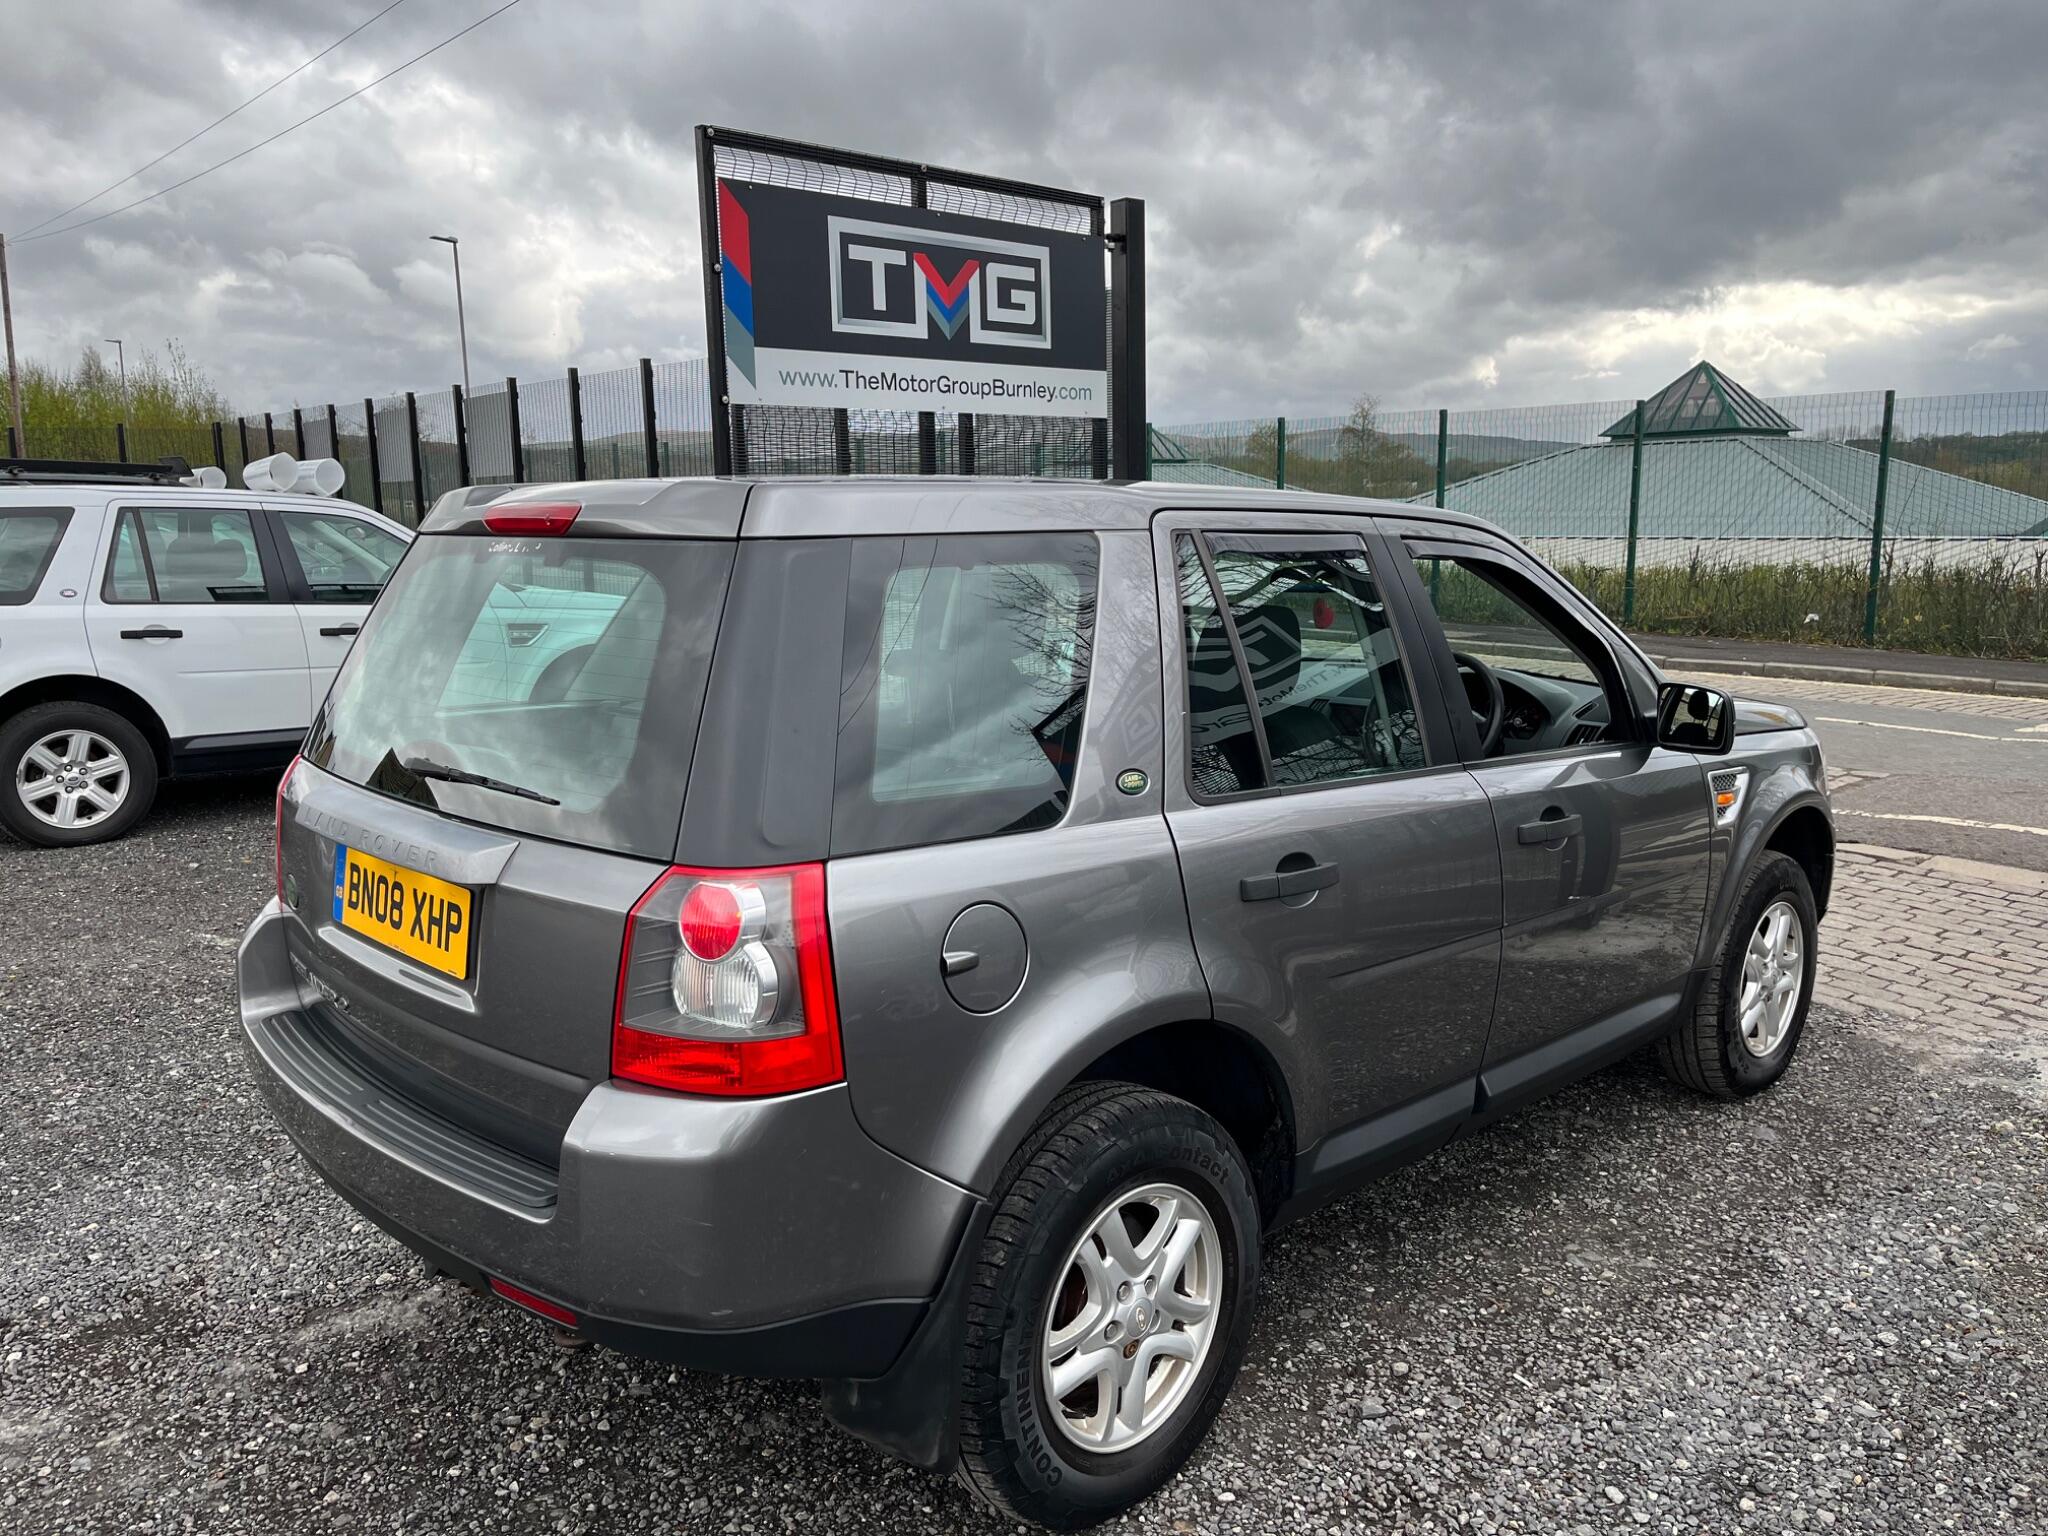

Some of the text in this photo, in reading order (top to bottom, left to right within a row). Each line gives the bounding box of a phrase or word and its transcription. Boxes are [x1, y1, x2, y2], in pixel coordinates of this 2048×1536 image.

[848, 244, 1036, 340] TMG
[778, 369, 1093, 402] www.TheMotorGroupBurnley.com
[358, 828, 438, 872] ROVER
[347, 861, 404, 931] BN08
[409, 887, 463, 953] XHP
